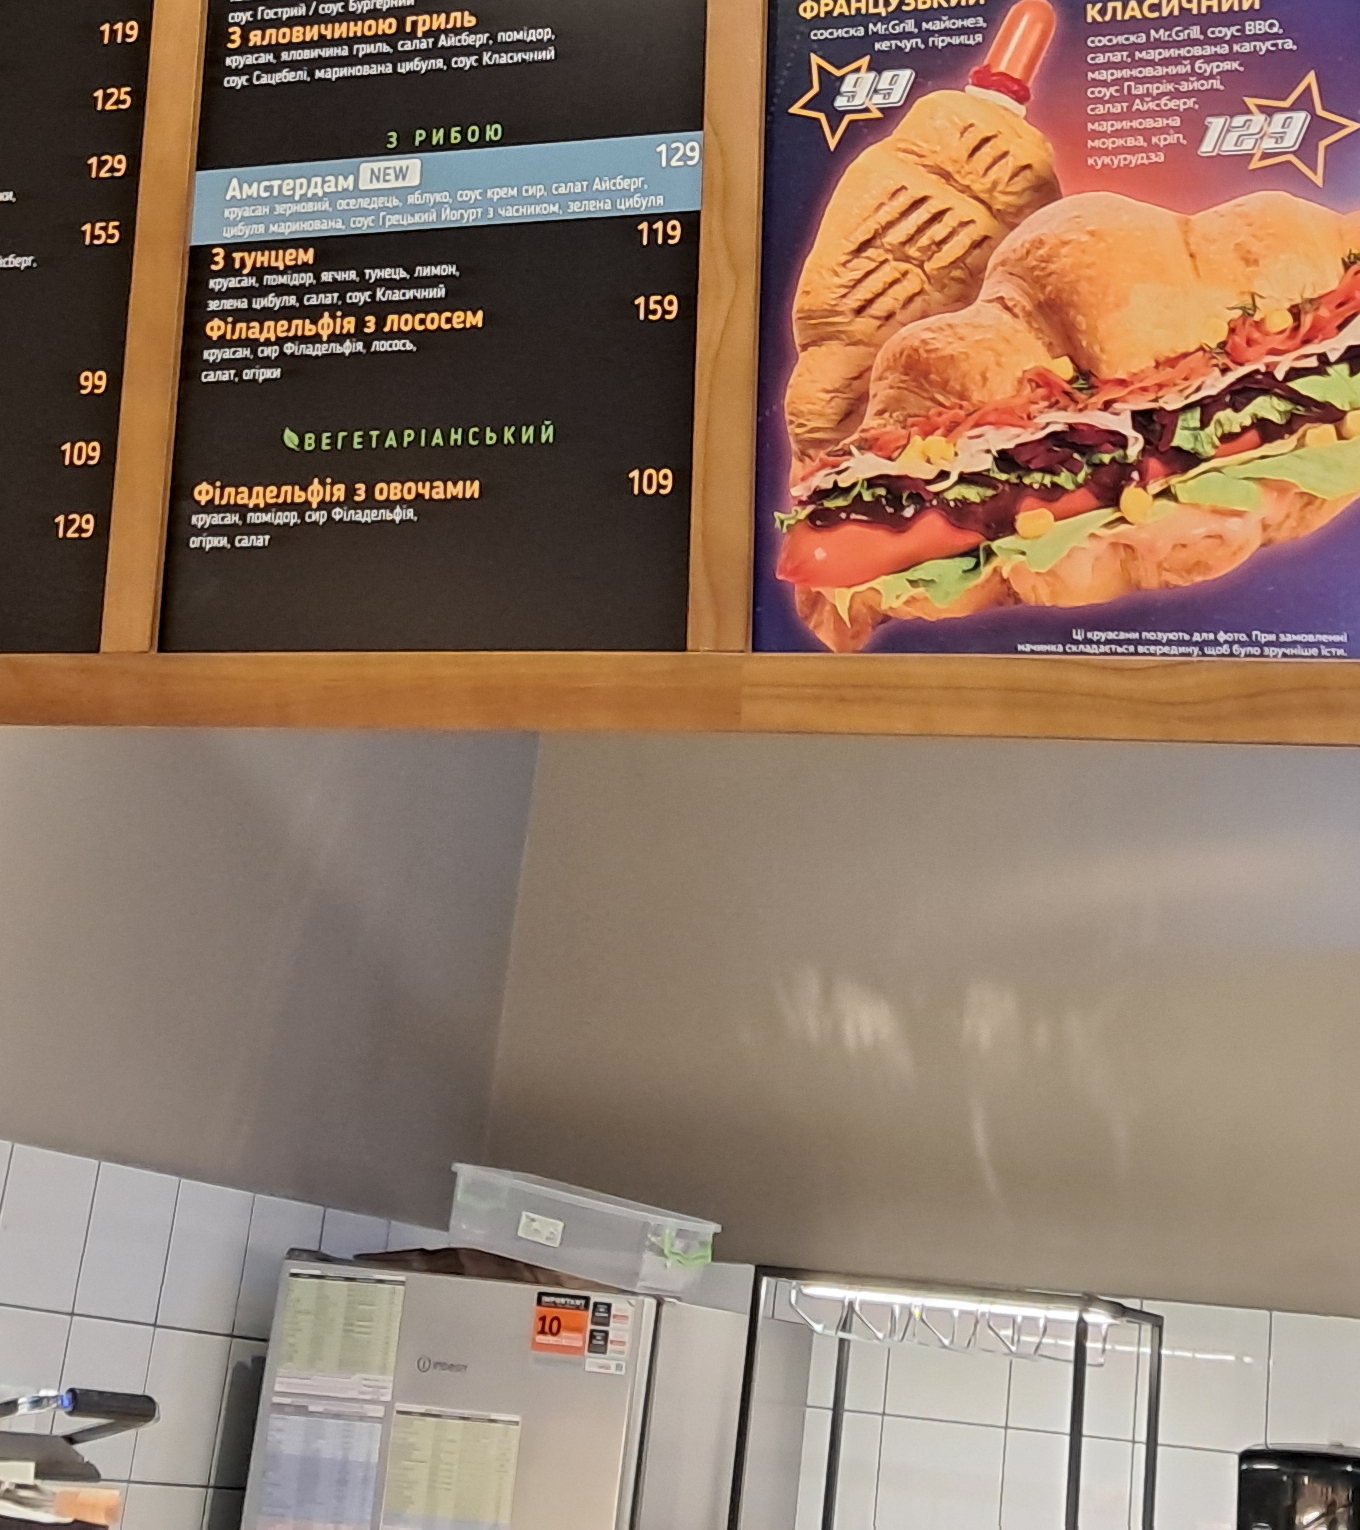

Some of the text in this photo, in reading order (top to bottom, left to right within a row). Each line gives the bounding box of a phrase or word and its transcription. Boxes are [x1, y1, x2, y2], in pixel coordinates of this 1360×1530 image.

[99, 20, 139, 45] 119
[248, 17, 398, 47] яловичиною
[405, 10, 477, 38] гриль
[810, 15, 988, 40] сосиска Mr.Grill, майонез,
[1086, 19, 1284, 48] сосиска Mr.Grill, соус BBQ,
[93, 86, 132, 111] 125
[833, 68, 916, 111] 99
[1086, 75, 1225, 101] соус Папрік-айолі,
[414, 123, 503, 147] РИБОЮ
[1198, 110, 1311, 156] 129
[86, 154, 127, 179] 129
[655, 141, 703, 168] 129
[1087, 151, 1165, 170] кукурудза
[225, 165, 409, 200] Амстердам NEW
[80, 221, 120, 246] 155
[637, 219, 682, 246] 119
[231, 247, 315, 275] тунцем
[634, 294, 679, 321] 159
[205, 310, 356, 343] Філадельфія
[382, 309, 484, 333] лососем
[79, 370, 107, 395] 99
[303, 420, 555, 451] ВЕГЕТАРІАНСЬКИЙ
[60, 441, 101, 466] 109
[193, 477, 346, 509] Філадельфія
[374, 479, 480, 508] овочами
[628, 468, 673, 495] 109
[54, 513, 95, 539] 129
[537, 1315, 561, 1337] 10
